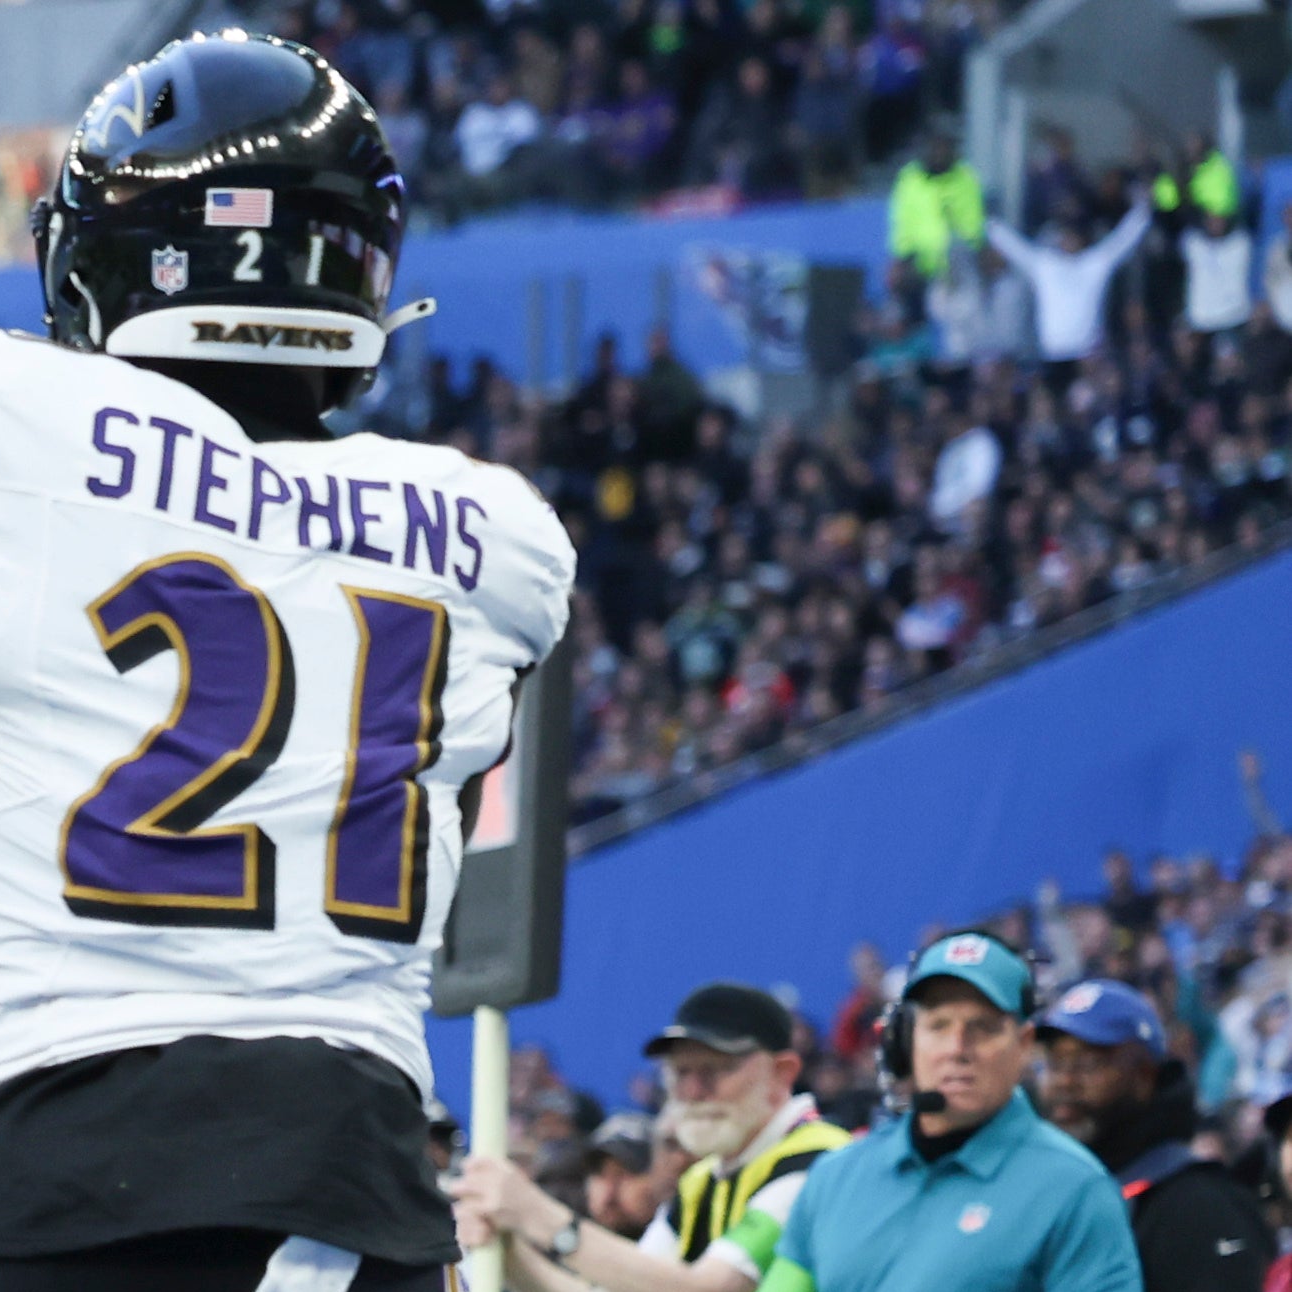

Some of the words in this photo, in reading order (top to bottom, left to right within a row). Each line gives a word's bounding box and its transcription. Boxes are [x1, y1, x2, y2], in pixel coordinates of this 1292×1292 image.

[191, 321, 354, 352] RAVENS
[86, 406, 488, 593] STEPHENS
[58, 550, 453, 945] 21
